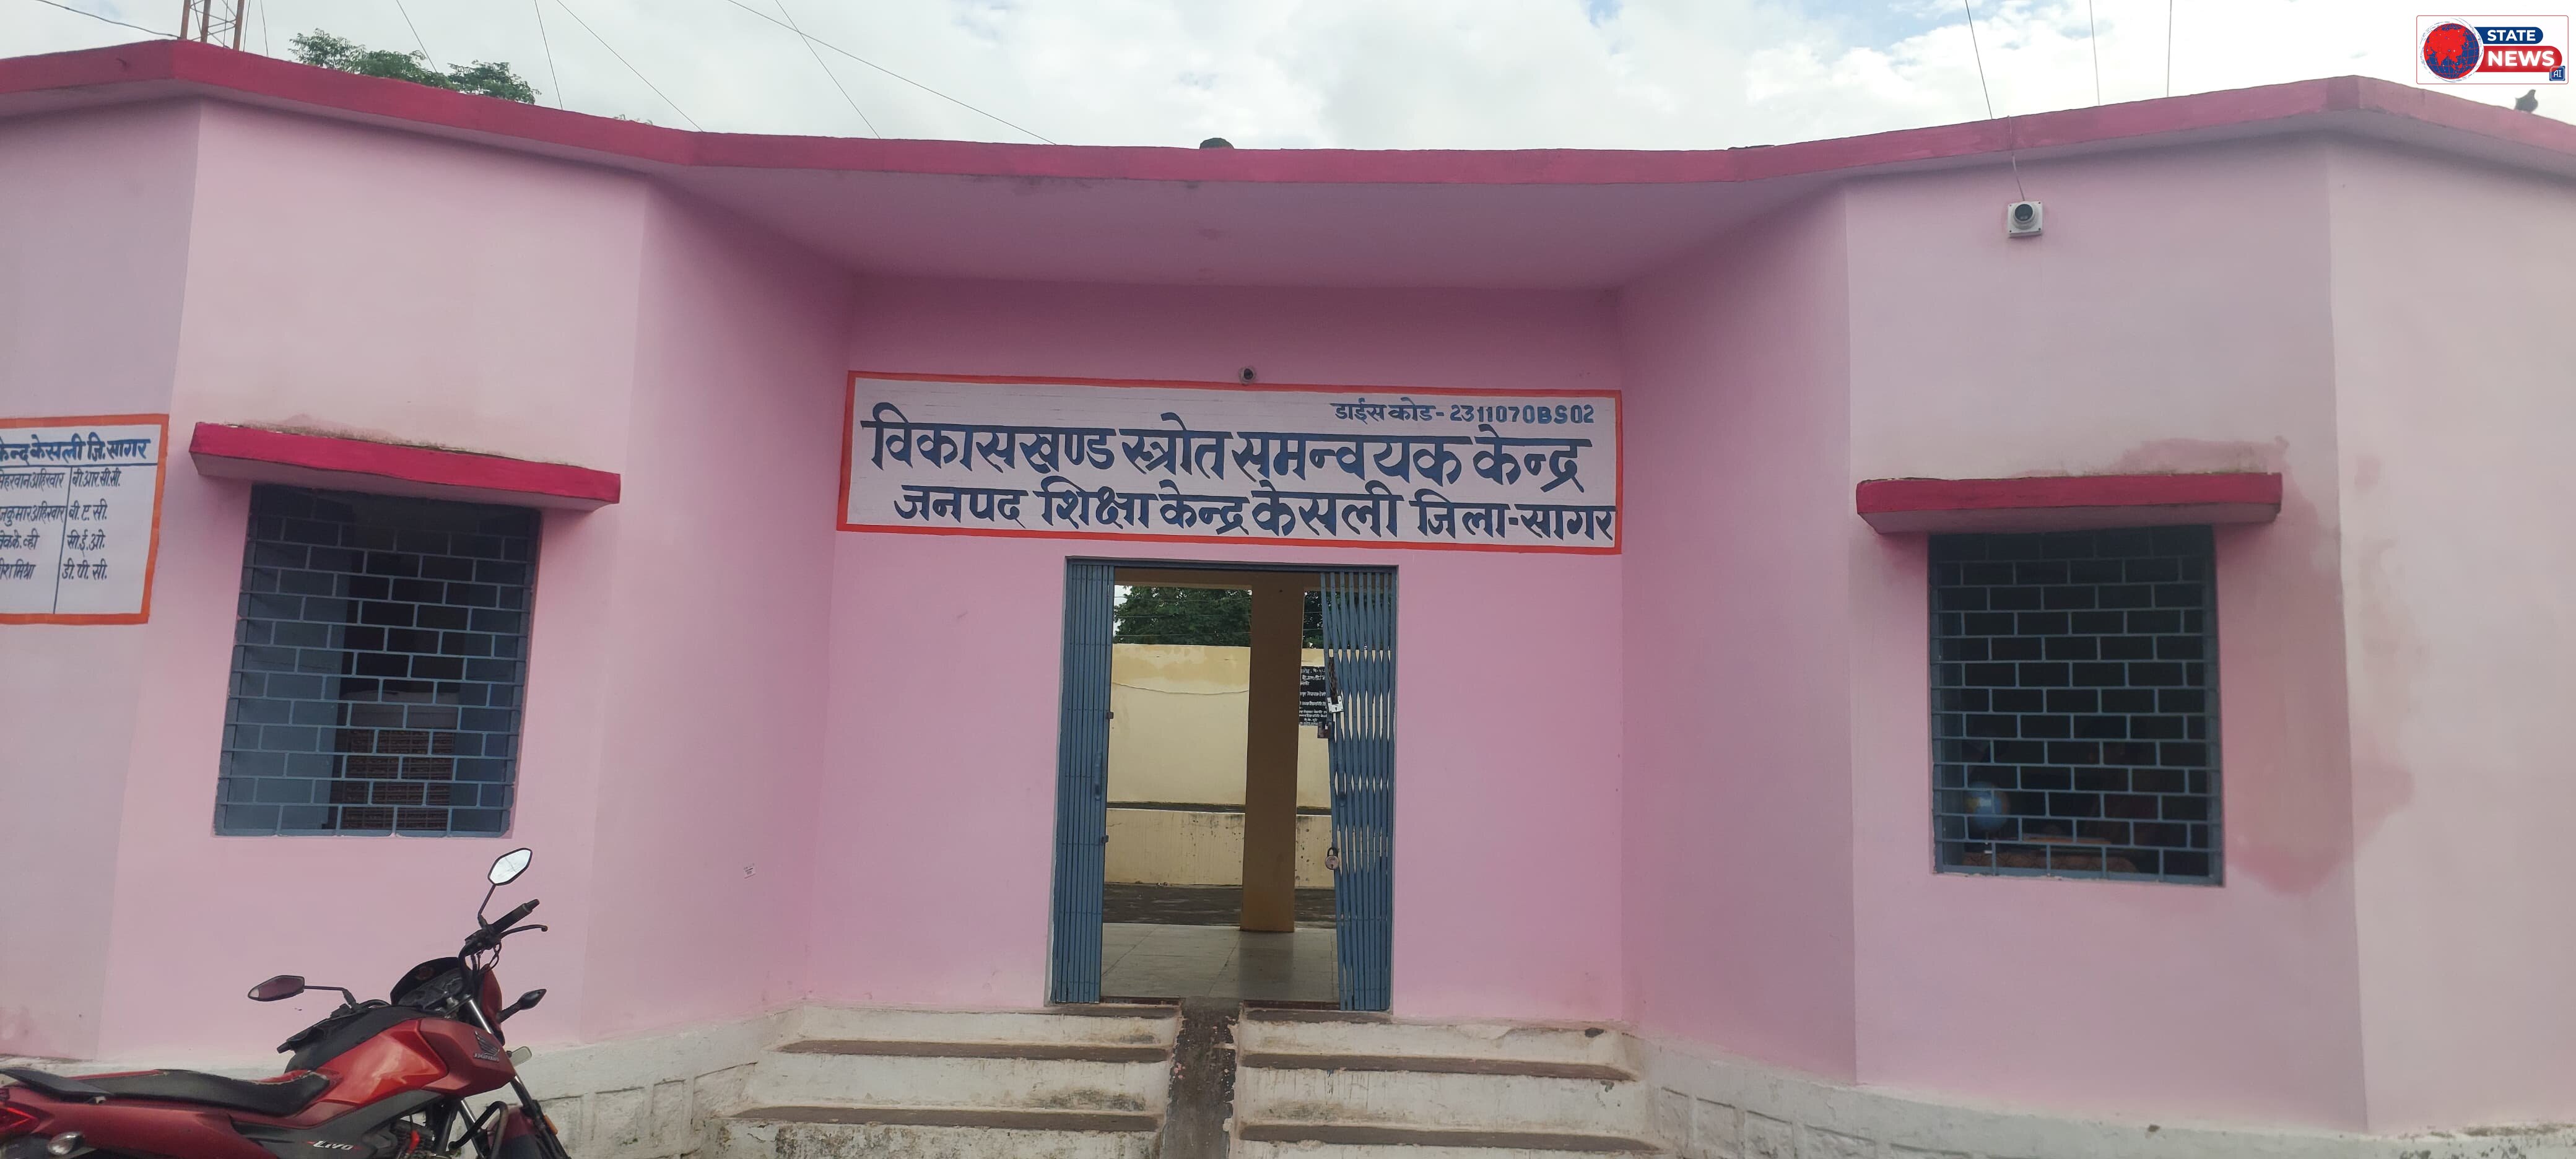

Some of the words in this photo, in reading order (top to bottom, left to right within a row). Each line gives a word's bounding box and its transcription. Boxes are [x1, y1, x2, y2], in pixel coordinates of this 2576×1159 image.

[1450, 404, 1595, 425] 2311070BS02
[30, 433, 86, 463] केसली
[861, 402, 1116, 473] विकासखण्ड
[1232, 432, 1473, 487] समन्वयक
[1473, 424, 1593, 492] केन्द्र
[894, 485, 1029, 528] जनपद
[1033, 475, 1159, 529] शिक्षा
[1159, 479, 1250, 535] केन्द्र
[1251, 479, 1404, 537] केसली
